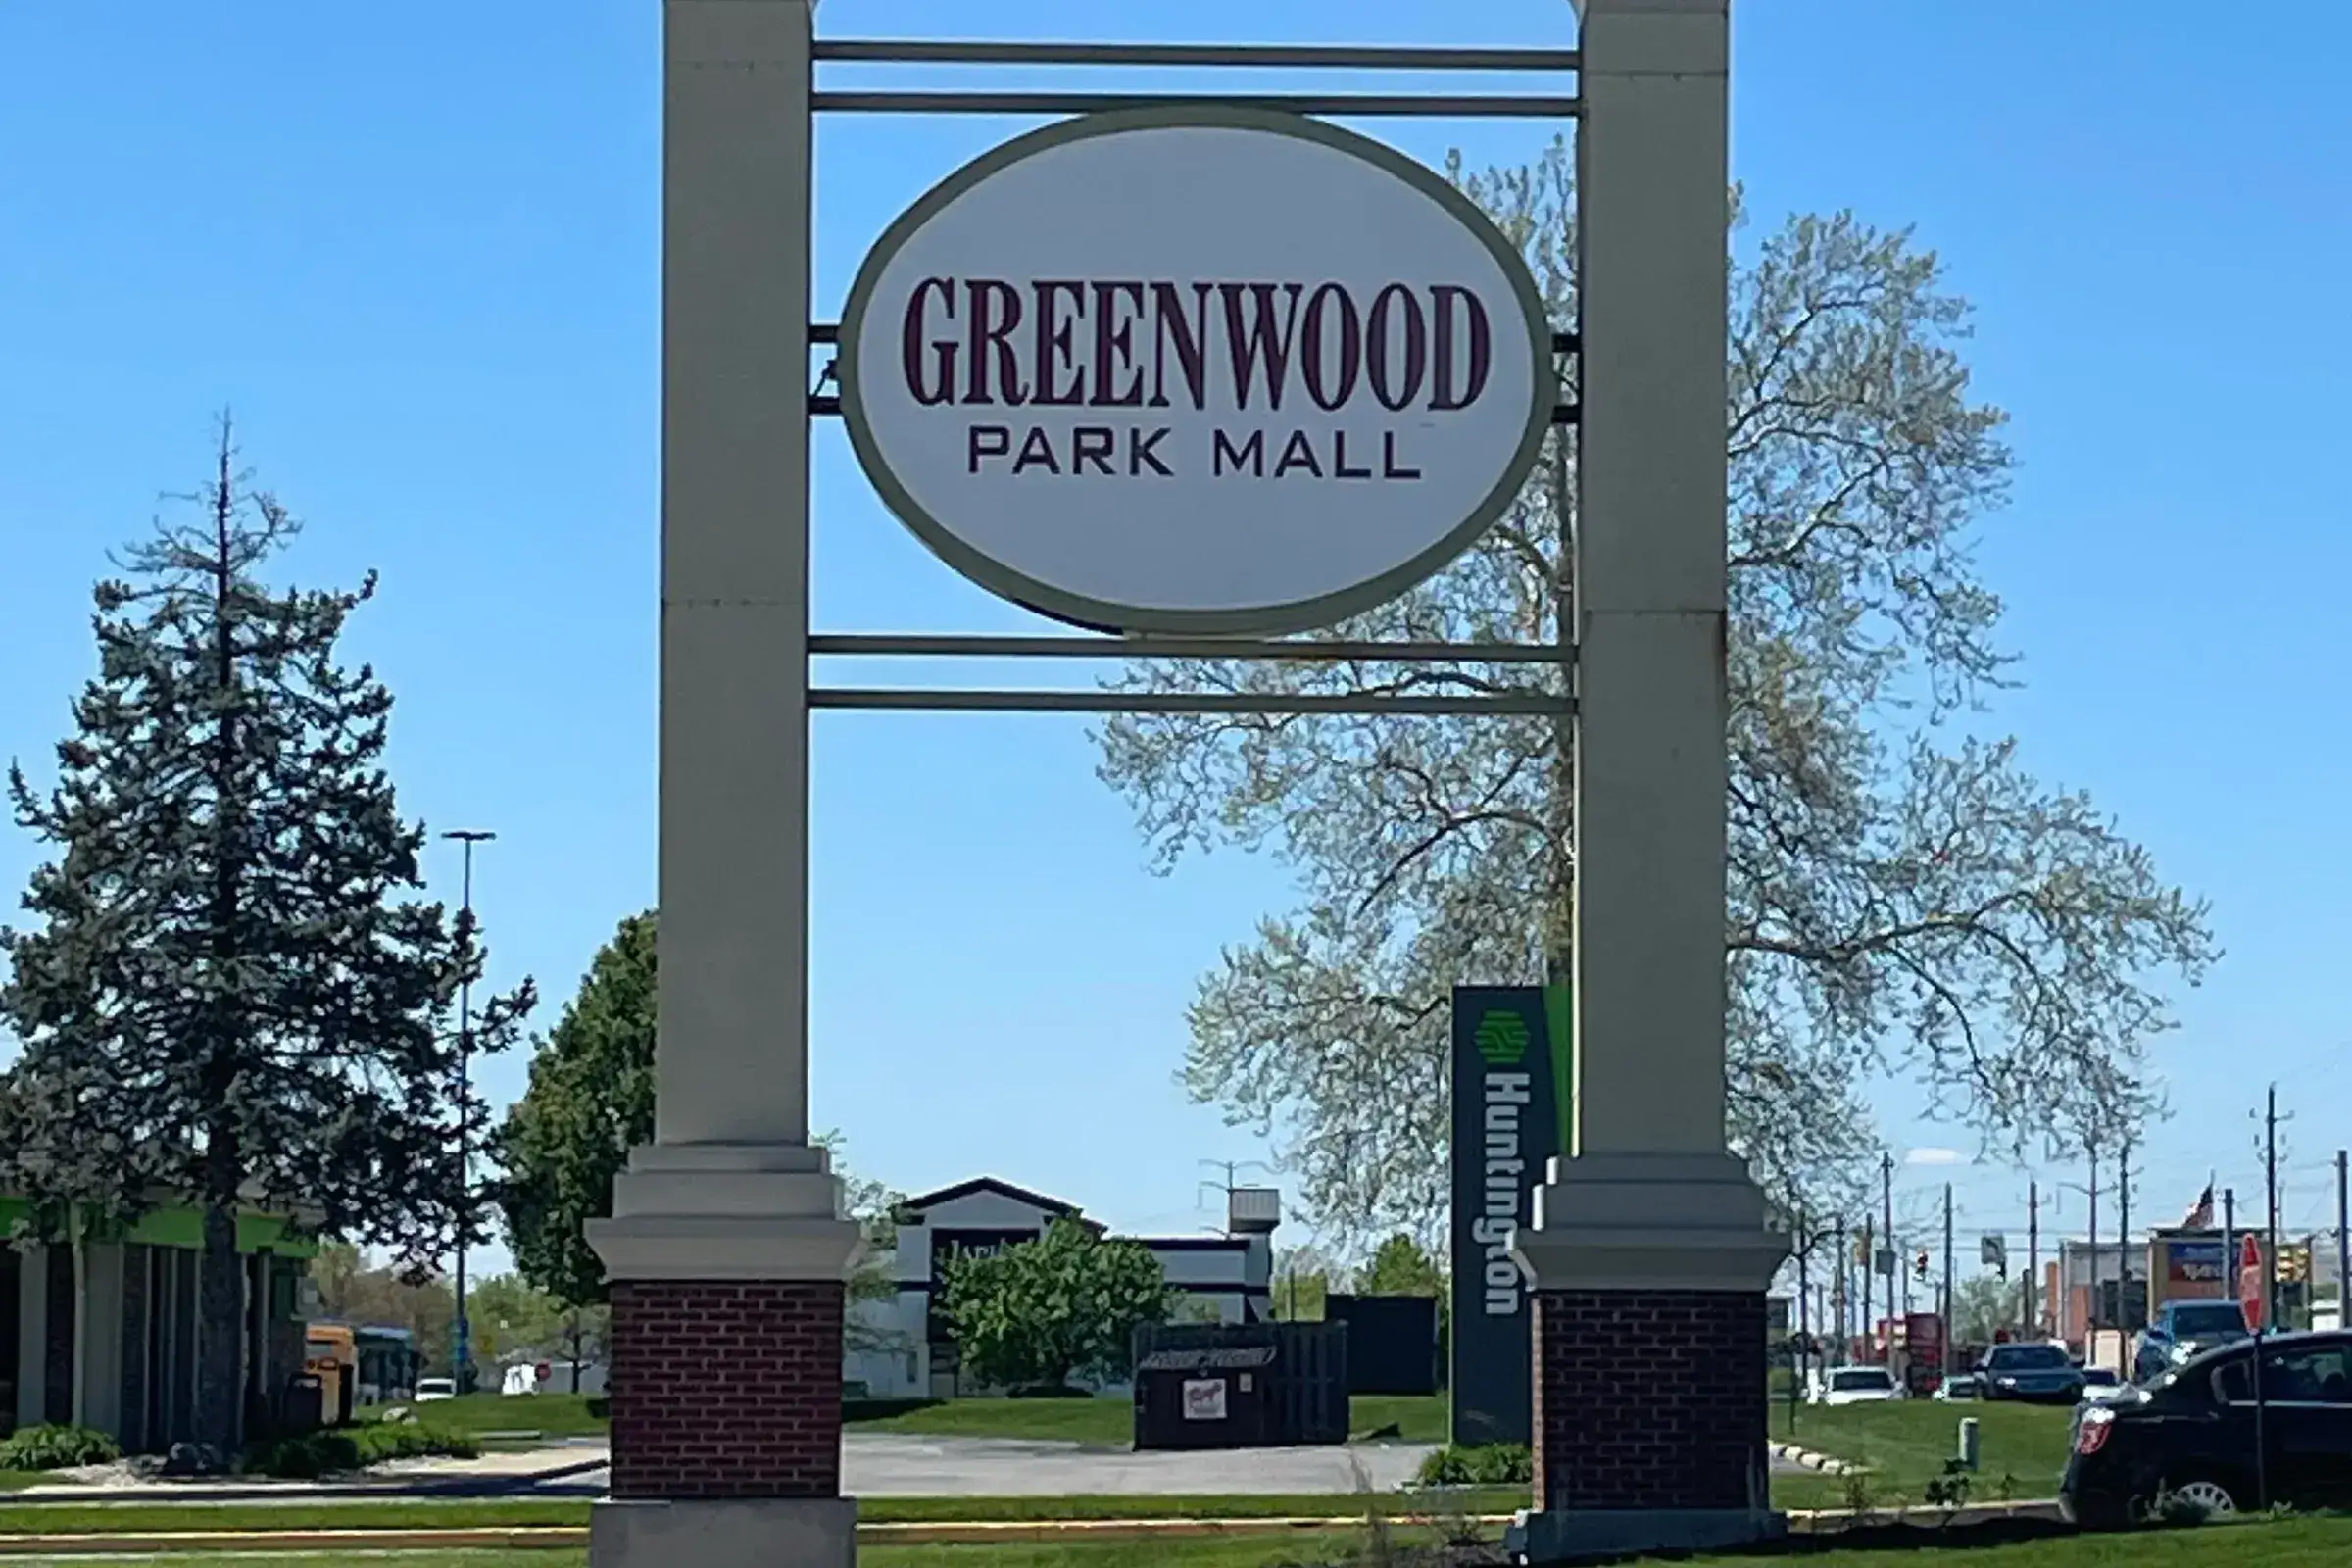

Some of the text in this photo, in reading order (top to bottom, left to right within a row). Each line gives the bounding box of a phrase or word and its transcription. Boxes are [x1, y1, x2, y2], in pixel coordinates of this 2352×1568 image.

[902, 276, 1491, 412] GREENWOOD
[967, 425, 1422, 479] PARK MALL
